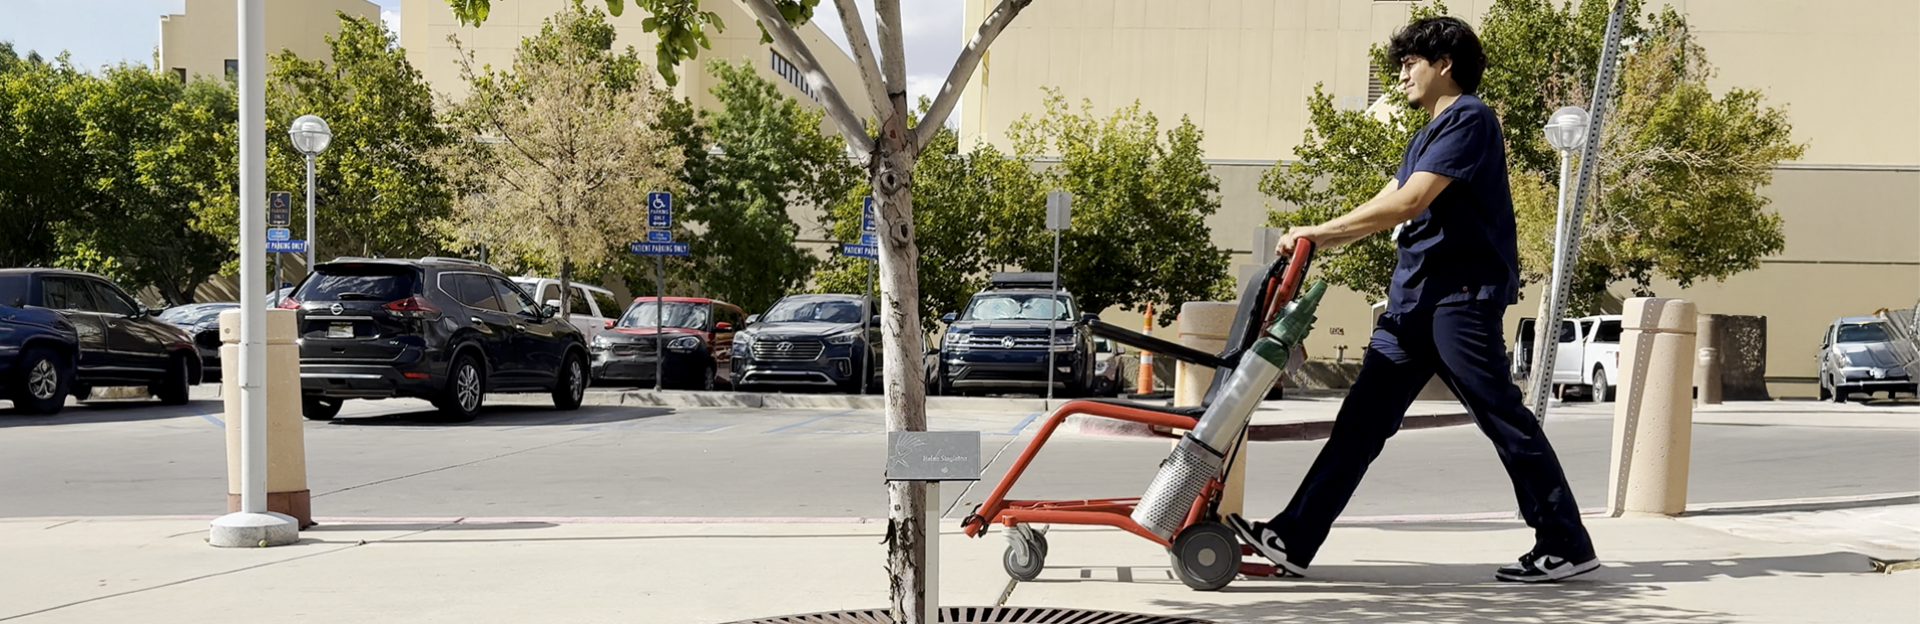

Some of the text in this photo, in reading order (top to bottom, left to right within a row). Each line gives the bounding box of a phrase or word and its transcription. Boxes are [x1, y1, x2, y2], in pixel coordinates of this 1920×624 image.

[271, 242, 291, 250] PARKING
[291, 242, 304, 250] ONLY
[631, 244, 687, 253] PATIENT PARKING ONLY
[844, 246, 864, 255] PATIENT
